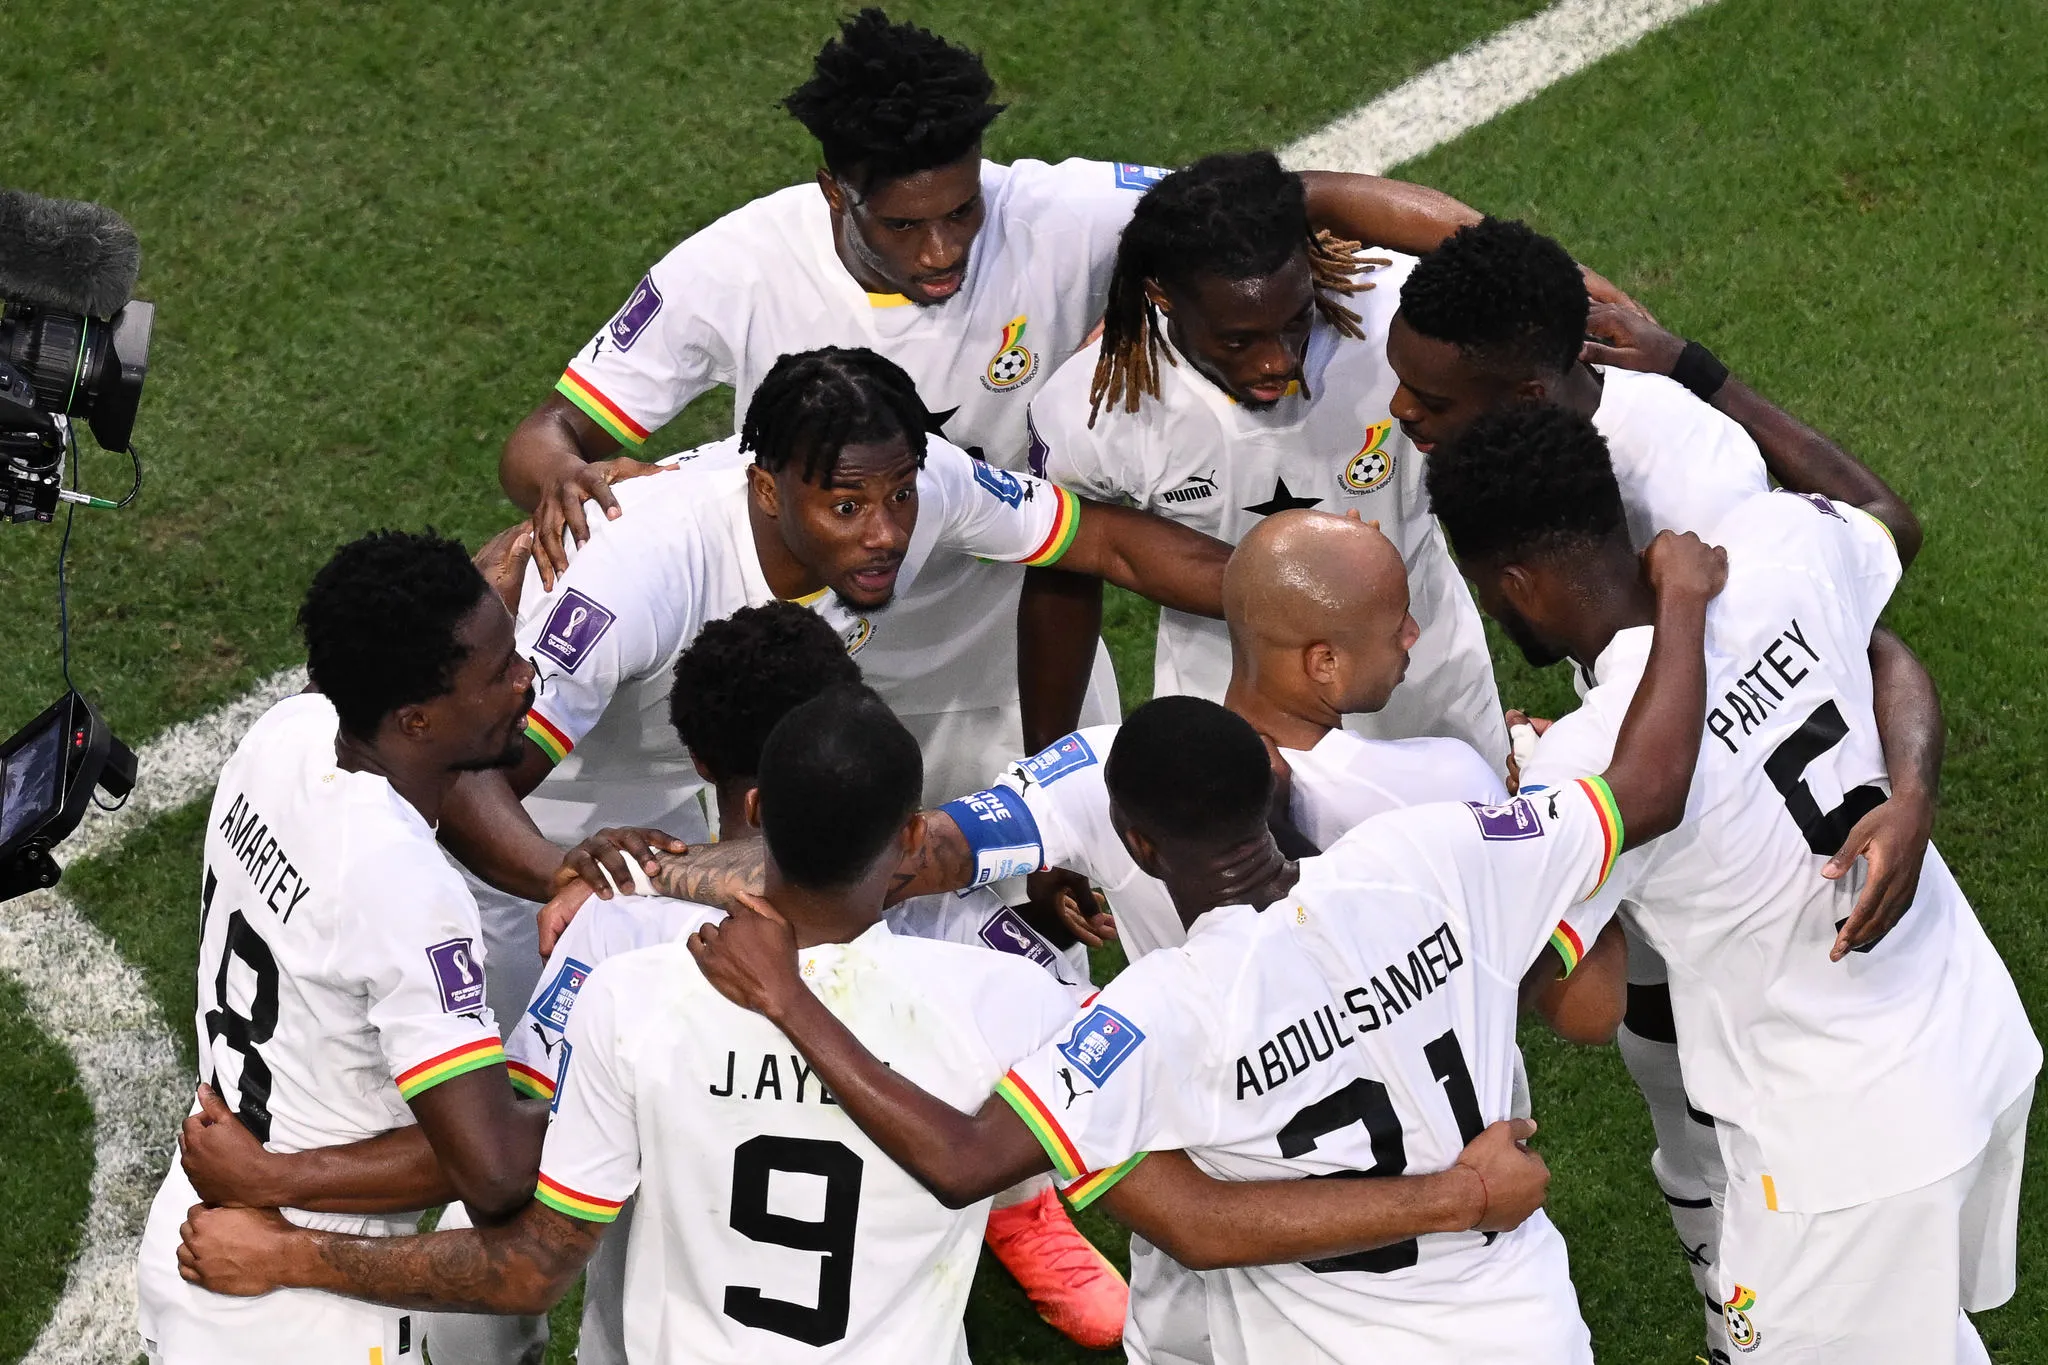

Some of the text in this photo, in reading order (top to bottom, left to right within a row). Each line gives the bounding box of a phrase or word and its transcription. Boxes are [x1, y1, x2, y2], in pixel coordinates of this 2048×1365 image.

[1162, 484, 1212, 503] PUMA
[1706, 618, 1820, 754] PARTEY
[219, 792, 310, 925] AMARTEY
[980, 791, 1012, 821] THE
[1236, 921, 1464, 1101] ABDUL-SAMED
[1275, 1027, 1499, 1274] 21
[723, 1134, 864, 1348] 9
